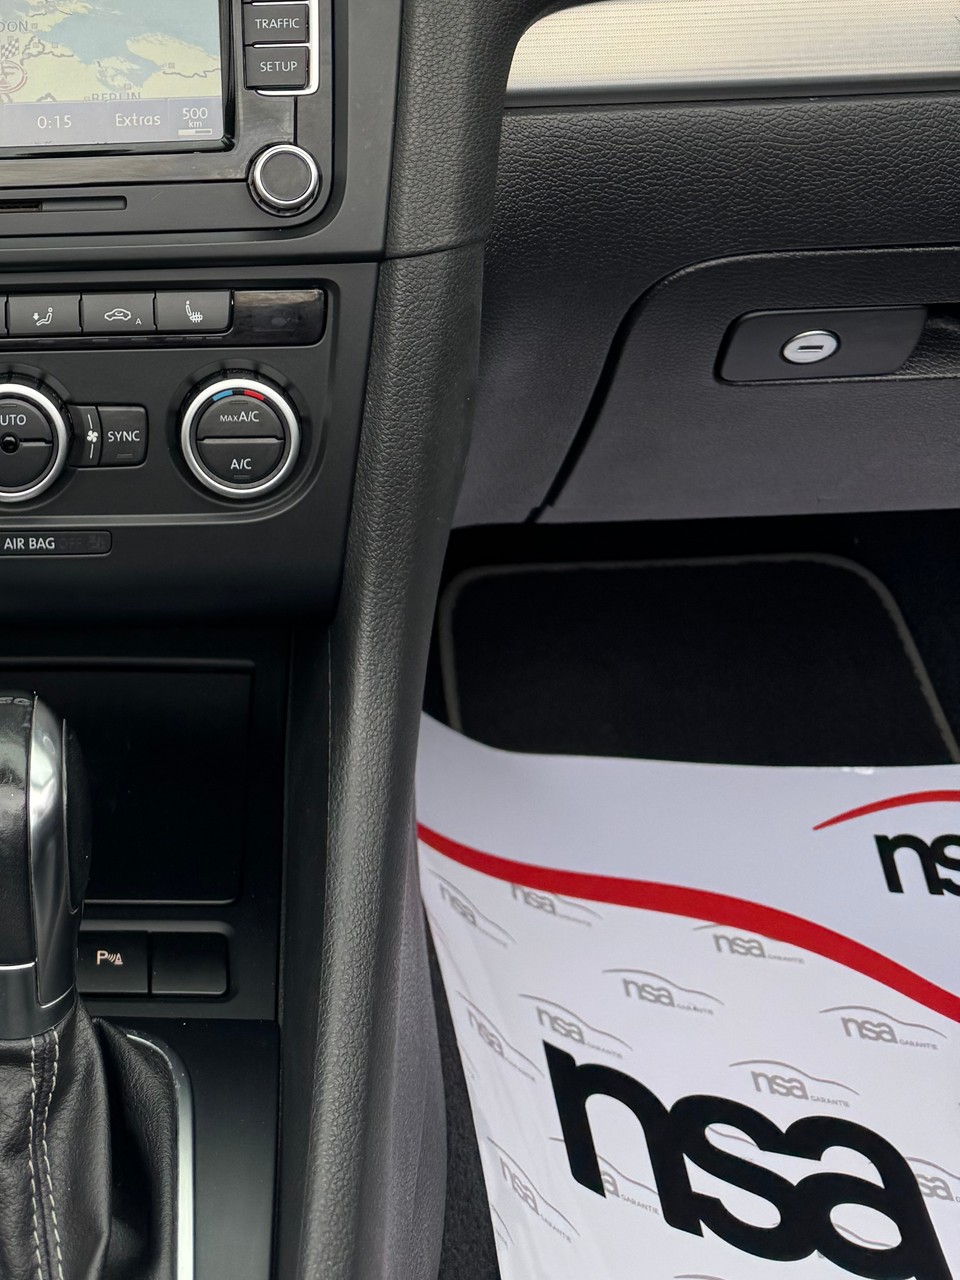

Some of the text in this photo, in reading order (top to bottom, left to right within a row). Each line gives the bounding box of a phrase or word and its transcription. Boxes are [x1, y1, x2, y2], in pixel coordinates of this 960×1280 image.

[255, 18, 300, 29] TRAFFIC
[260, 61, 298, 72] SETUP
[115, 113, 161, 127] Extras
[182, 107, 208, 120] 500
[37, 115, 72, 128] 0:15
[188, 119, 203, 128] km
[219, 410, 260, 422] MAX A/C
[107, 431, 140, 442] SYNC
[230, 458, 252, 470] A/C
[4, 537, 25, 550] AIR
[29, 537, 55, 550] BAG
[511, 883, 556, 915] nsa
[713, 933, 766, 958] nsa
[622, 978, 675, 1007] nsa
[536, 1006, 585, 1045] nsa
[841, 1016, 898, 1044] nsa
[751, 1070, 809, 1100] nsa
[543, 1040, 954, 1280] nsa
[500, 1156, 540, 1215] nsa
[915, 1173, 954, 1202] sa
